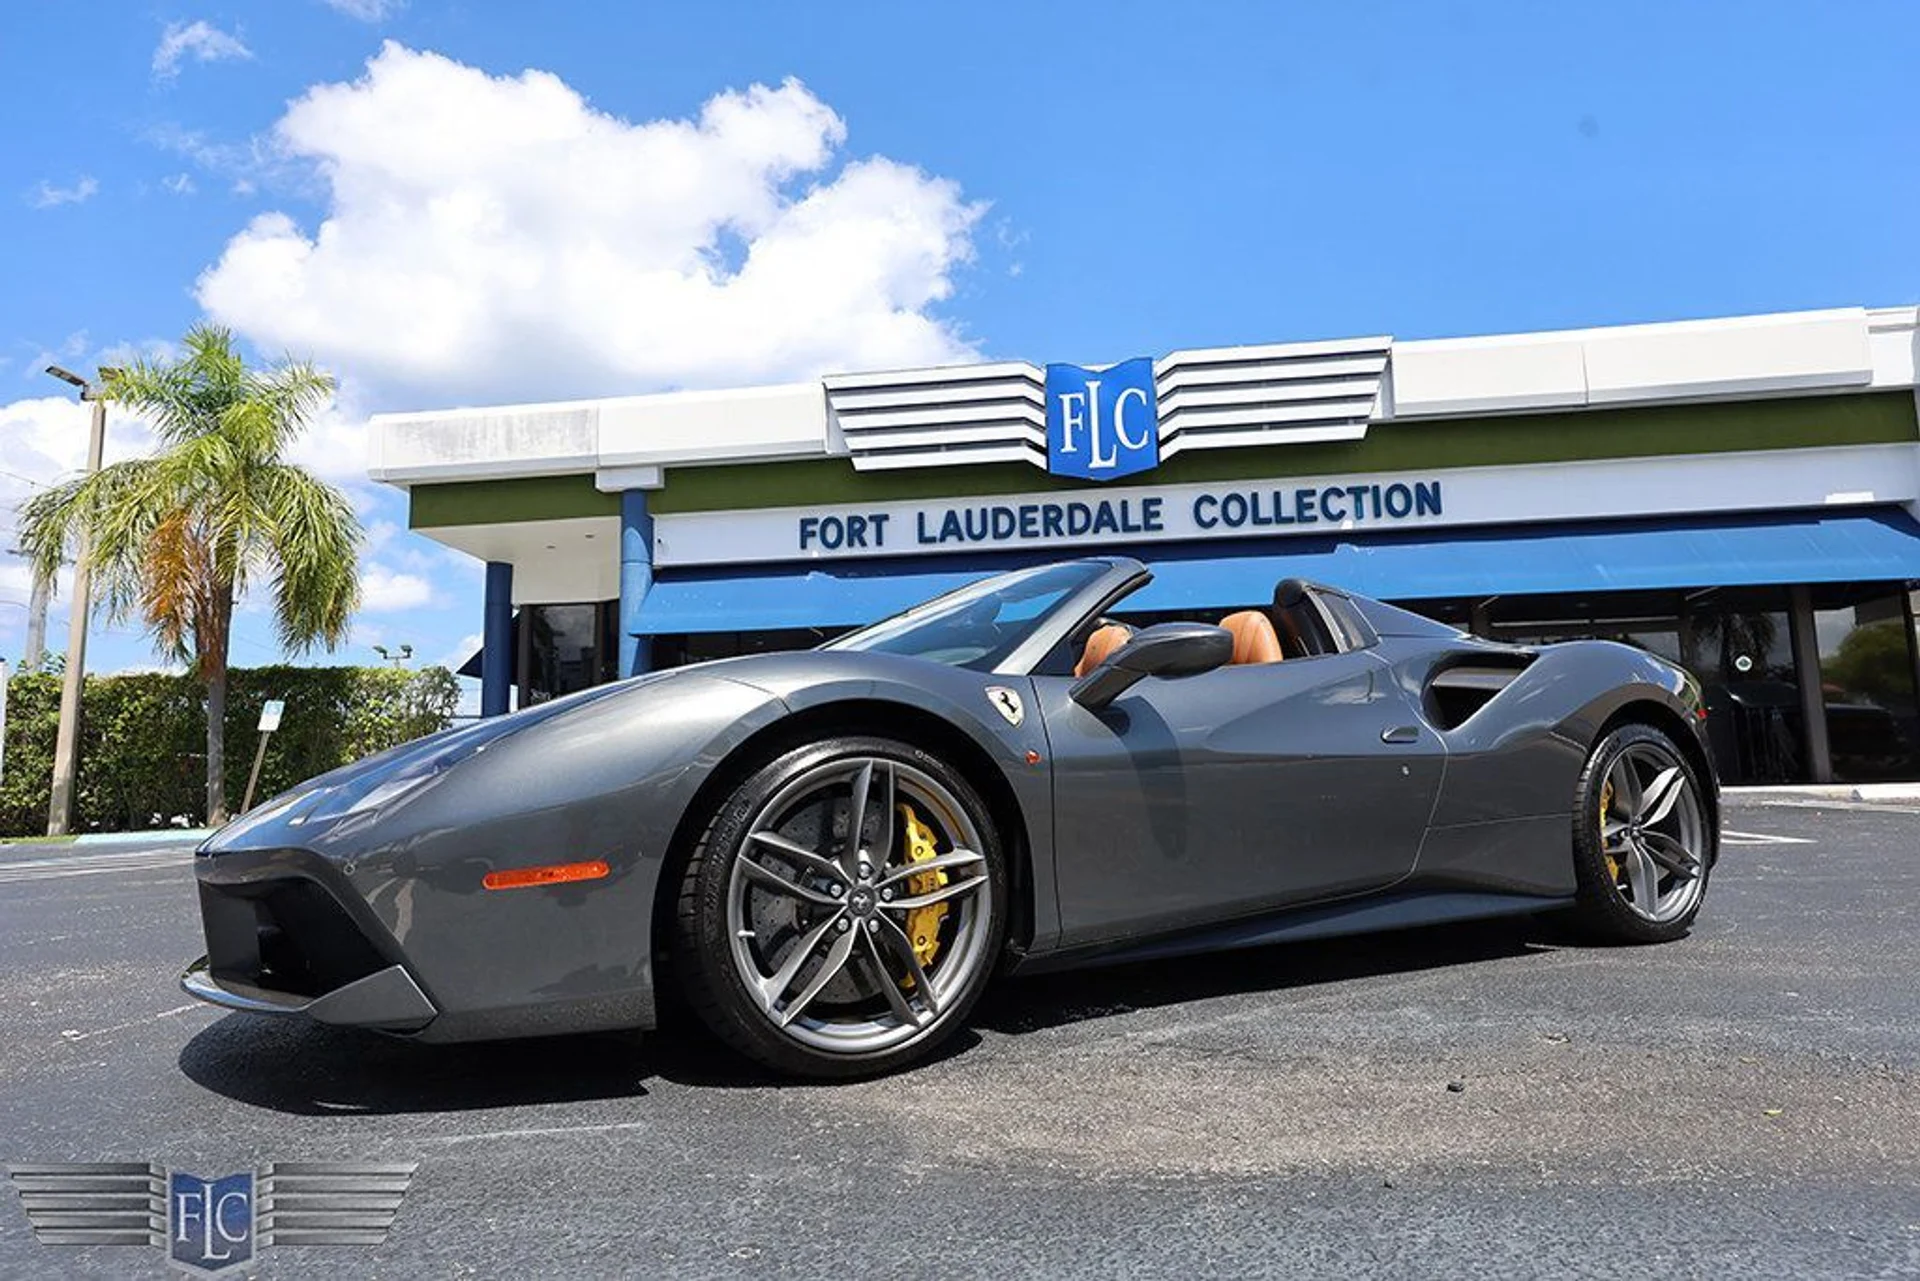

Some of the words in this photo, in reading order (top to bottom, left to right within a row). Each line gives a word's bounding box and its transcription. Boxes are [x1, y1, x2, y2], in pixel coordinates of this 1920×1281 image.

[1058, 380, 1149, 469] FLC
[800, 513, 890, 550] FORT
[917, 497, 1164, 545] LAUDERDALE
[1192, 481, 1443, 530] COLLECTION
